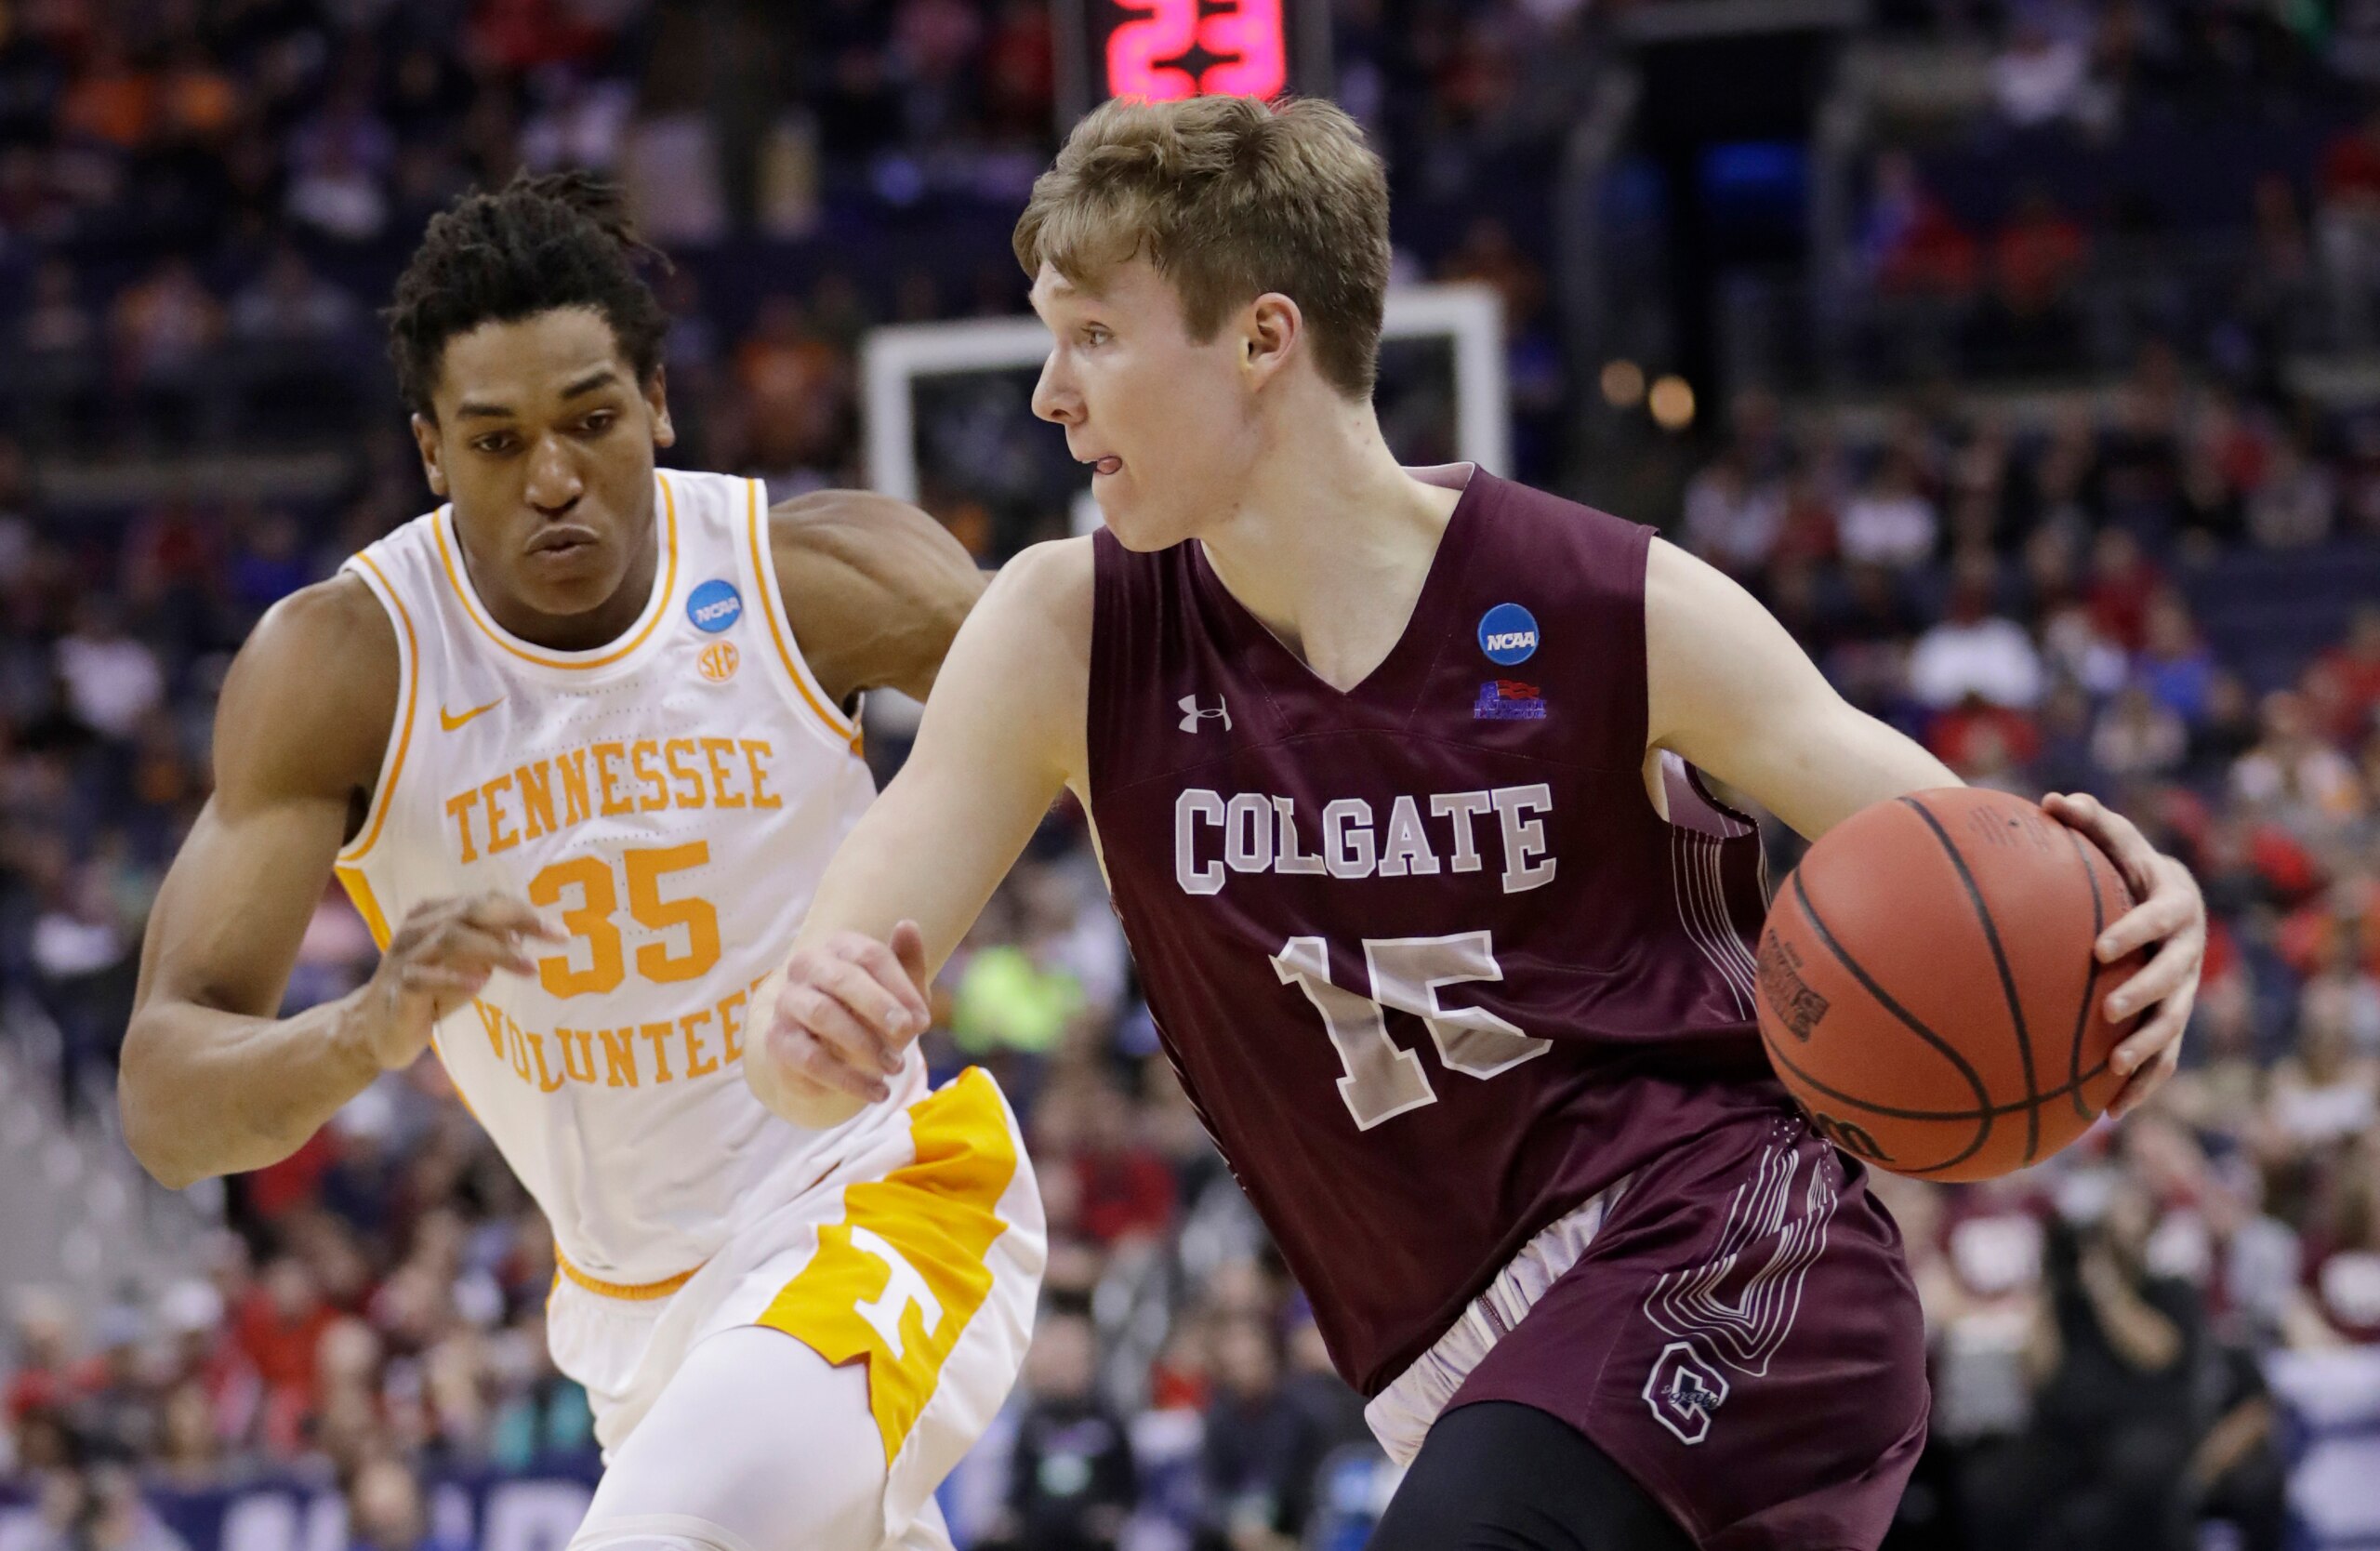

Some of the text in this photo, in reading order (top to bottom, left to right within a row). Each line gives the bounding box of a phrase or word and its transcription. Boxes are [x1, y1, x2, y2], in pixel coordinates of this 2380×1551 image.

[1106, 0, 1287, 106] 23
[695, 596, 742, 624] NCAA
[701, 643, 738, 679] SEC
[1487, 631, 1537, 651] NCAA
[446, 738, 783, 864] TENNESSEE
[1175, 783, 1557, 895] COLGATE
[528, 841, 722, 1000] 35
[471, 970, 770, 1094] VOLUNTEE
[1268, 930, 1554, 1132] 15
